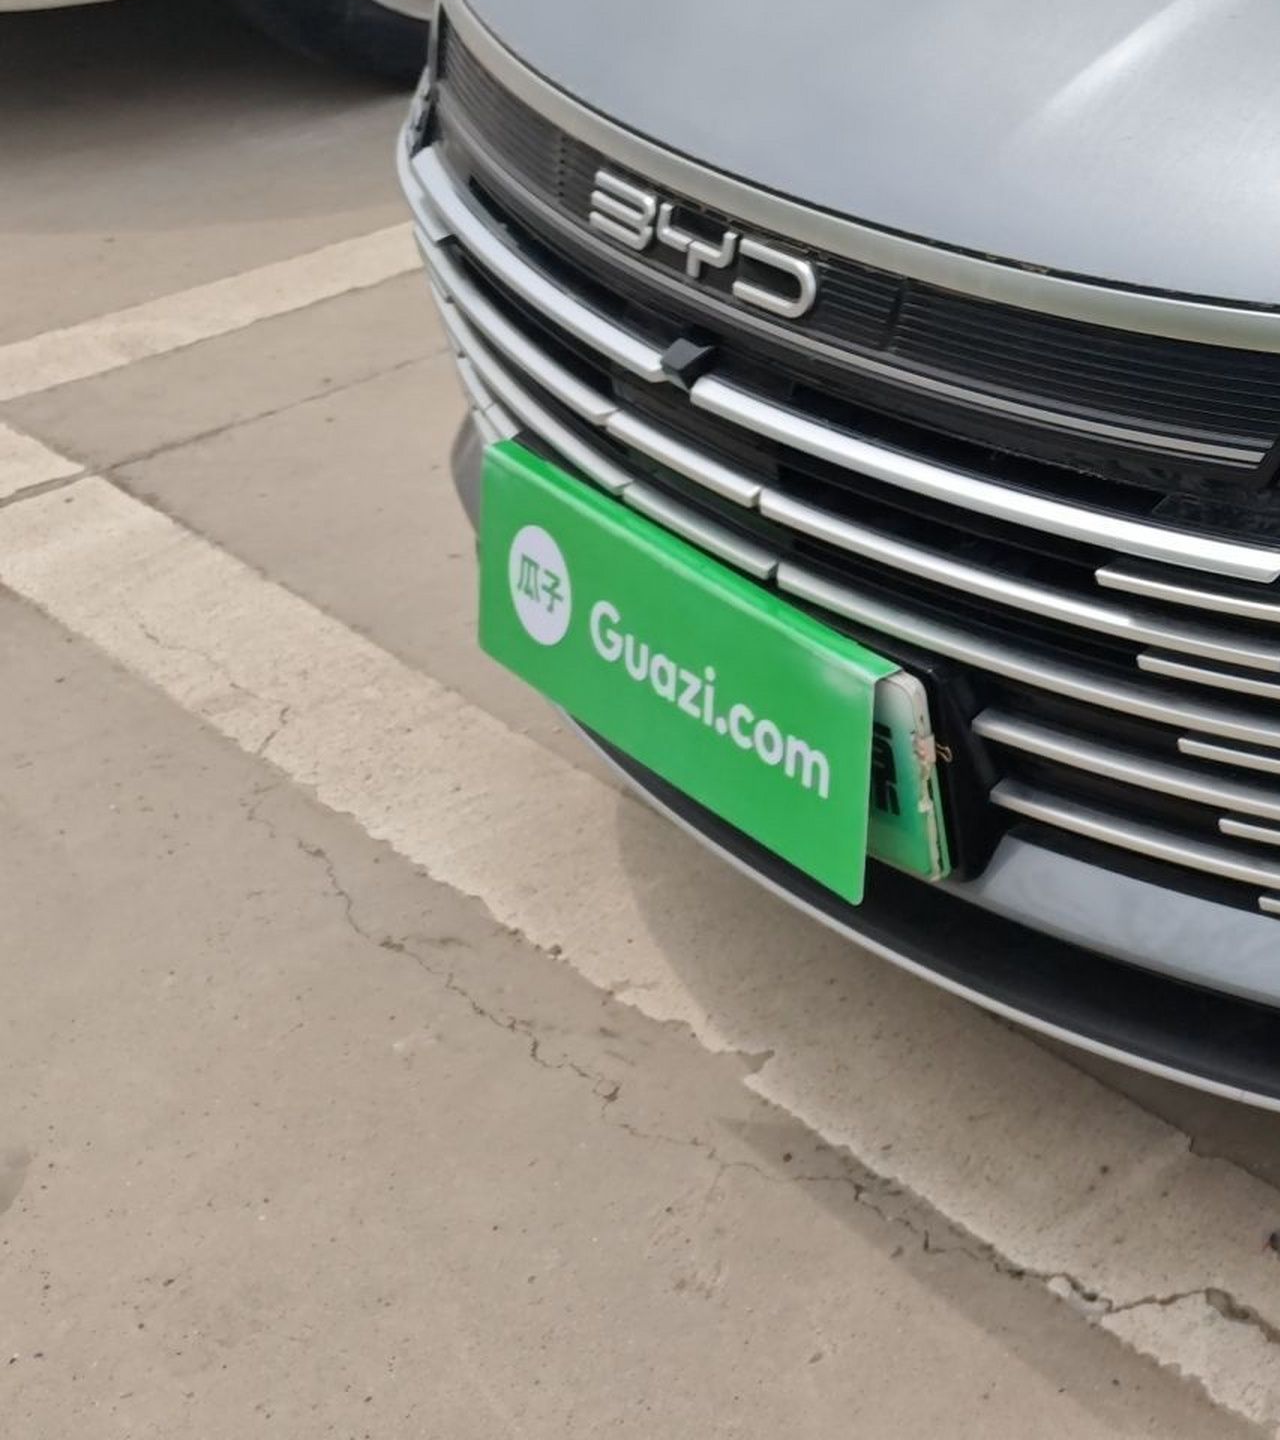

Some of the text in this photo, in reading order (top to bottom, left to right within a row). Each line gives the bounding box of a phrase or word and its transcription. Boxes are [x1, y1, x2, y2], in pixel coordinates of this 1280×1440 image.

[589, 170, 817, 319] BYD
[517, 553, 564, 613] 瓜子
[590, 600, 830, 799] Guazi.com
